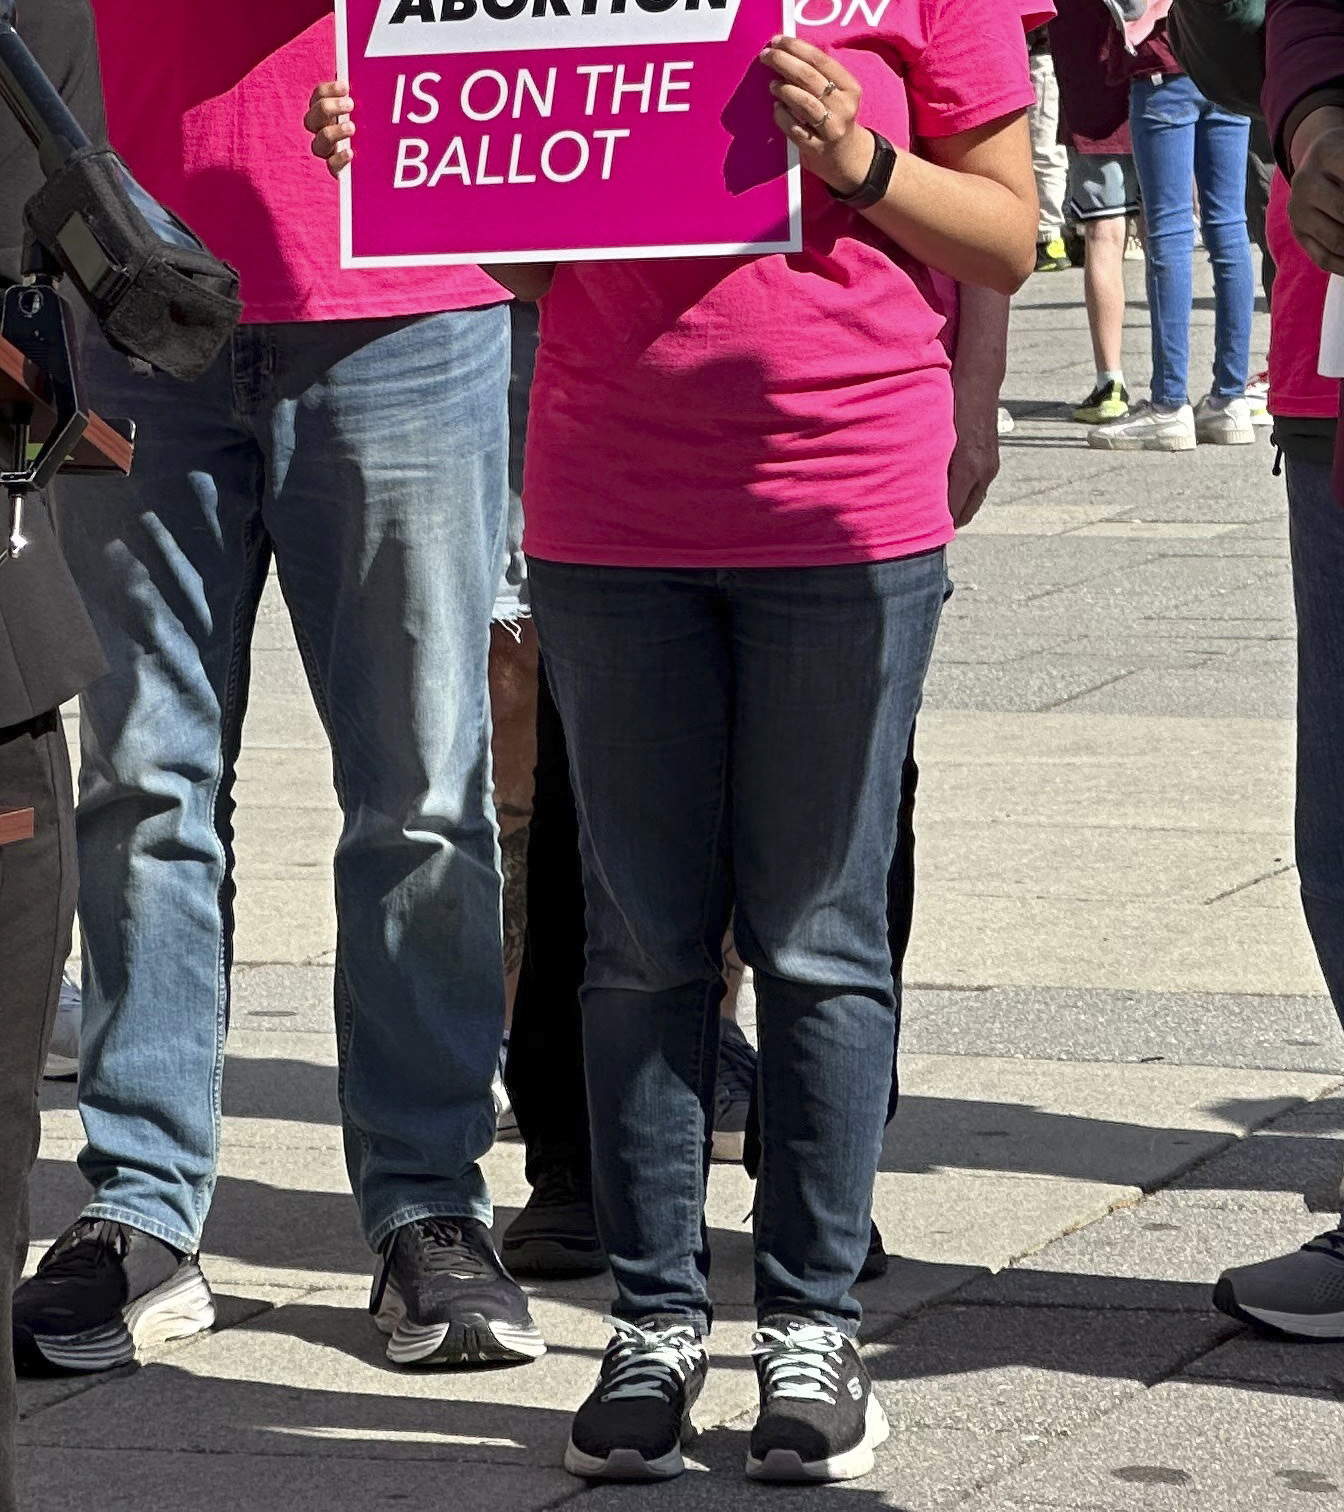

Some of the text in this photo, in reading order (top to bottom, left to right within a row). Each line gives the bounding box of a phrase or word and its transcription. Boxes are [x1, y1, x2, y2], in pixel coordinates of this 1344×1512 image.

[391, 61, 694, 124] IS ON THE
[393, 129, 631, 189] BALLOT
